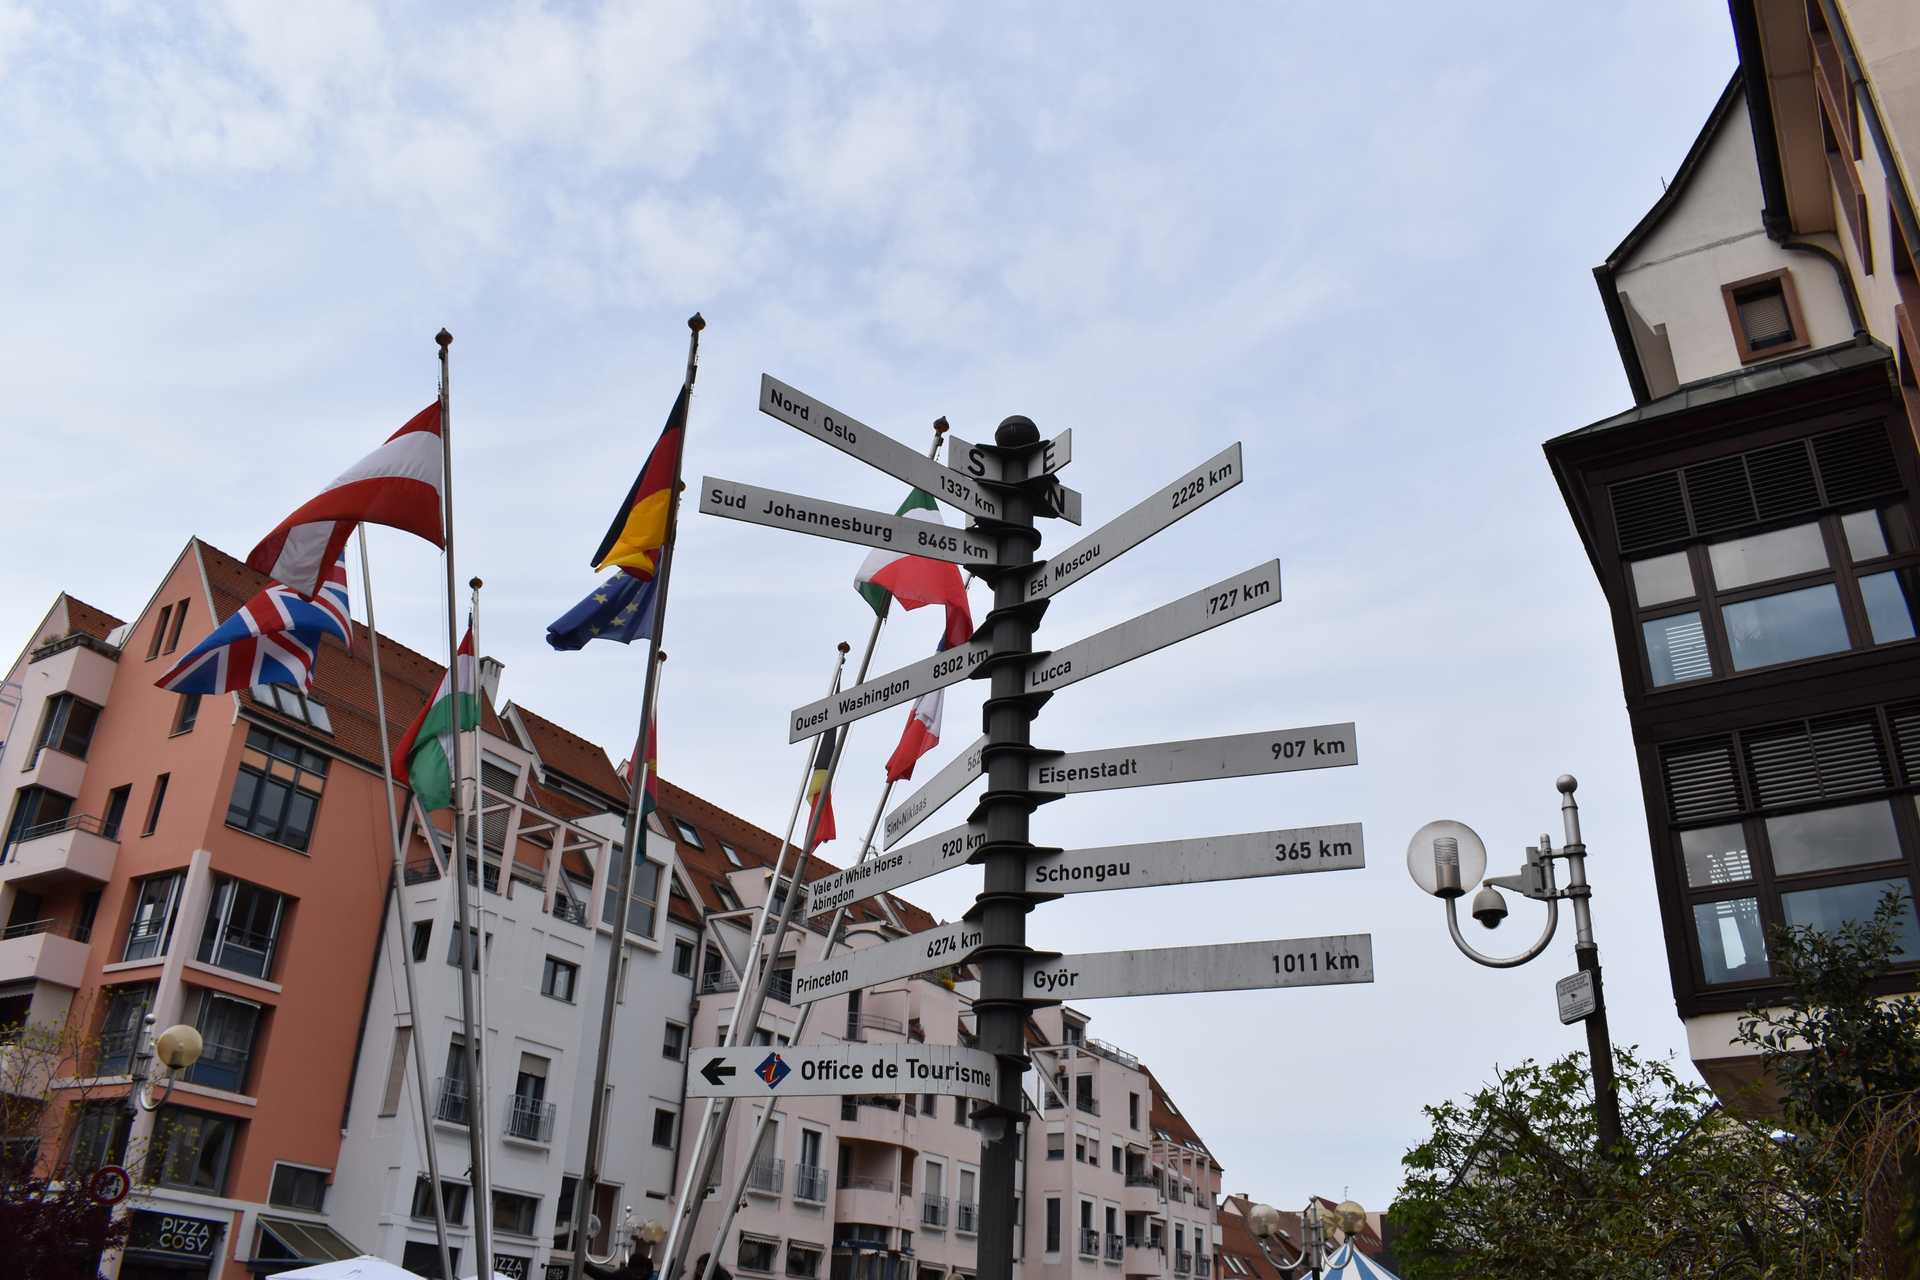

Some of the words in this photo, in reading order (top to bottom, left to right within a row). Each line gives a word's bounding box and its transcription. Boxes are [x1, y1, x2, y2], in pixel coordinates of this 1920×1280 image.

[771, 388, 809, 422] Nord
[823, 416, 858, 444] Oslo
[940, 475, 971, 501] 1337
[975, 492, 995, 515] km
[967, 448, 986, 477] S
[1042, 441, 1056, 474] E
[1047, 482, 1065, 514] N
[711, 488, 747, 510] Sud
[763, 499, 893, 542] Johannesburg
[917, 530, 958, 553] 8465
[963, 540, 989, 560] km
[1030, 574, 1048, 597] Est
[1055, 543, 1101, 581] Moscou
[1171, 478, 1205, 510] 2228
[1209, 462, 1233, 486] km
[1031, 659, 1072, 687] Lucca
[1208, 589, 1239, 616] 727
[1243, 579, 1270, 602] km
[795, 708, 829, 731] Ouest
[838, 679, 910, 716] Washington
[933, 654, 964, 679] 8302
[967, 648, 989, 667] km
[1038, 758, 1138, 784] Eisenstadt
[1271, 740, 1306, 760] 907
[1313, 737, 1345, 756] km
[886, 798, 927, 838] Sint-Niklaas
[813, 881, 832, 897] Vale
[834, 875, 844, 890] of
[845, 865, 871, 884] White
[874, 854, 903, 875] Horse
[941, 838, 963, 859] 920
[966, 832, 987, 851] km
[1035, 862, 1131, 883] Schongau
[1275, 840, 1311, 862] 365
[1319, 840, 1353, 858] km
[812, 888, 855, 913] Abingdon
[796, 968, 849, 994] Princeton
[926, 934, 957, 958] 6274
[961, 930, 982, 949] km
[1033, 969, 1080, 992] Györ
[1272, 953, 1319, 974] 1011
[1325, 951, 1360, 971] km
[801, 1058, 864, 1081] Office
[871, 1058, 899, 1079] de
[905, 1058, 992, 1088] Tourisme
[160, 1233, 208, 1252] COSY
[161, 1217, 210, 1238] PIZZA
[494, 1256, 523, 1273] IZZA
